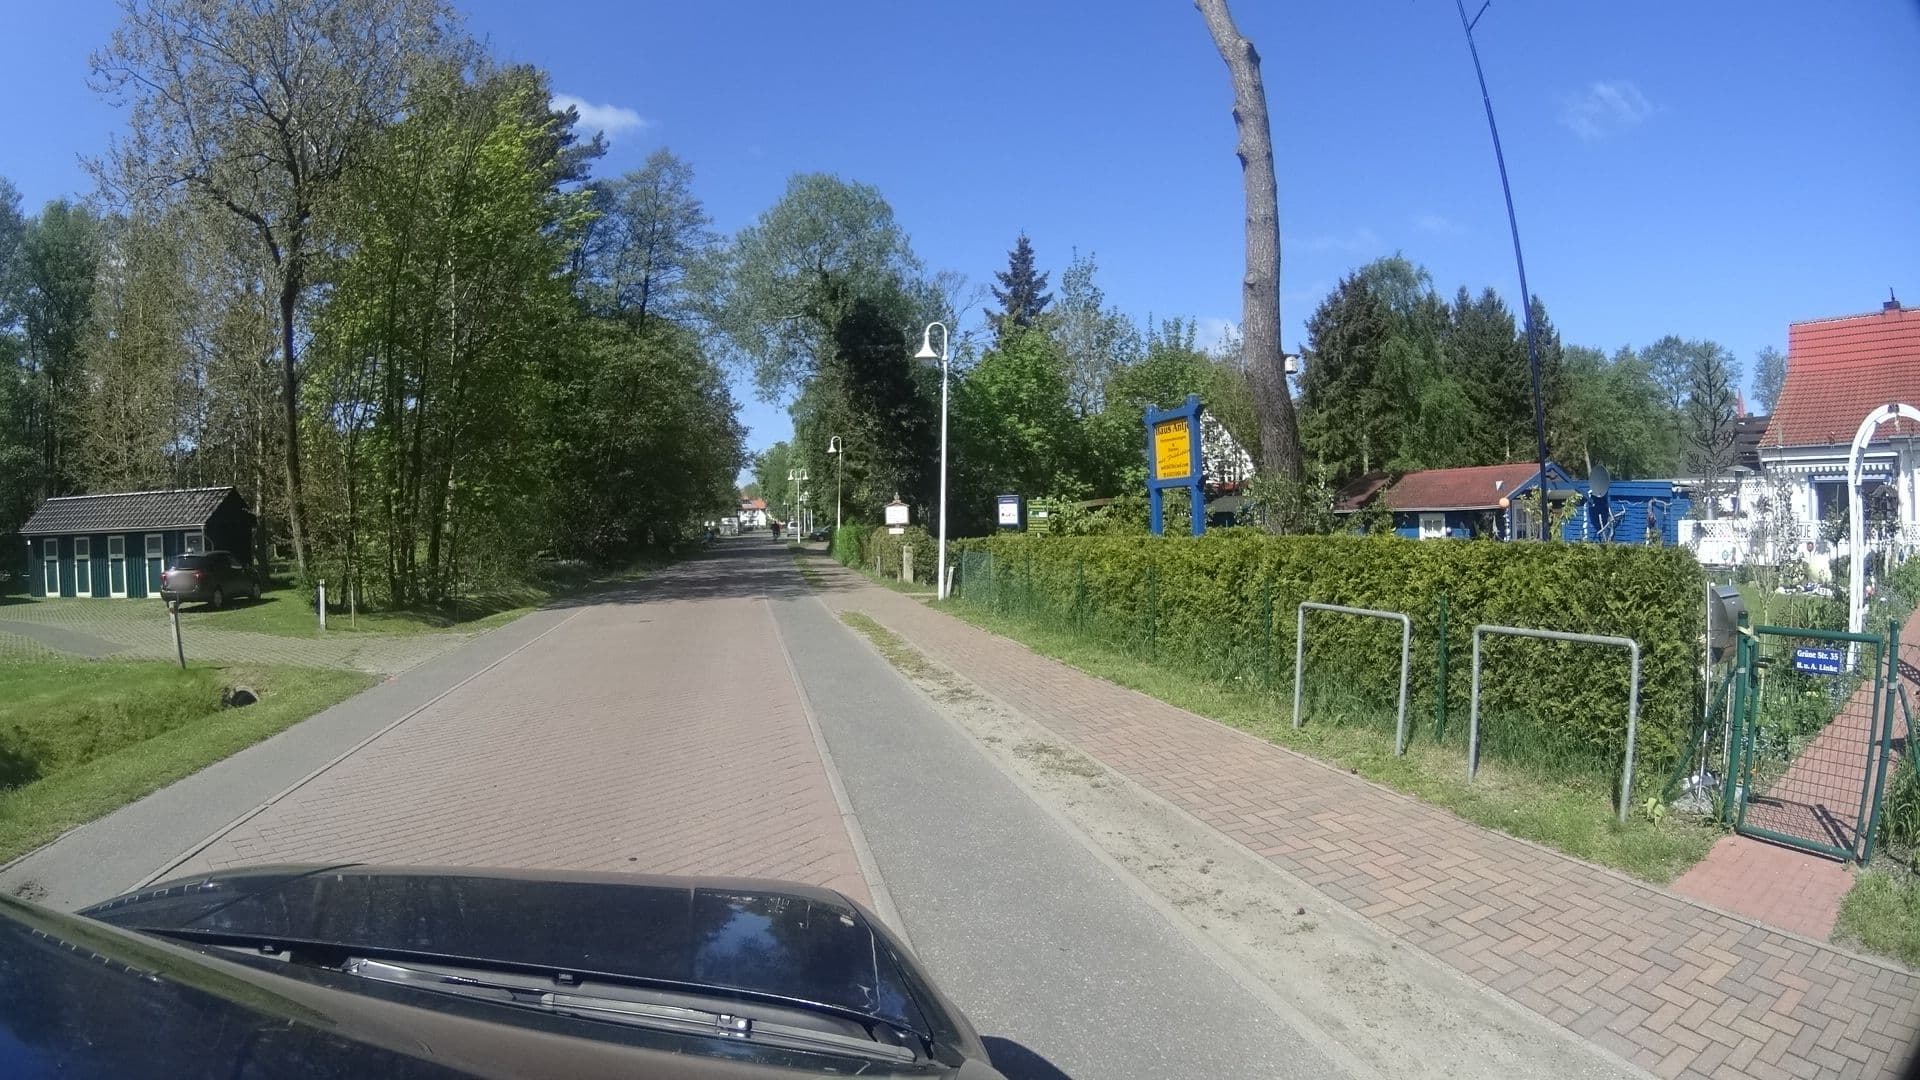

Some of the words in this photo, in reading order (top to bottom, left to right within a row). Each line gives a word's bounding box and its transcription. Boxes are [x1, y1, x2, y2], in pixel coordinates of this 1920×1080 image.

[1797, 649, 1816, 658] Grüne
[1817, 651, 1829, 660] Str.
[1830, 652, 1838, 661] 35
